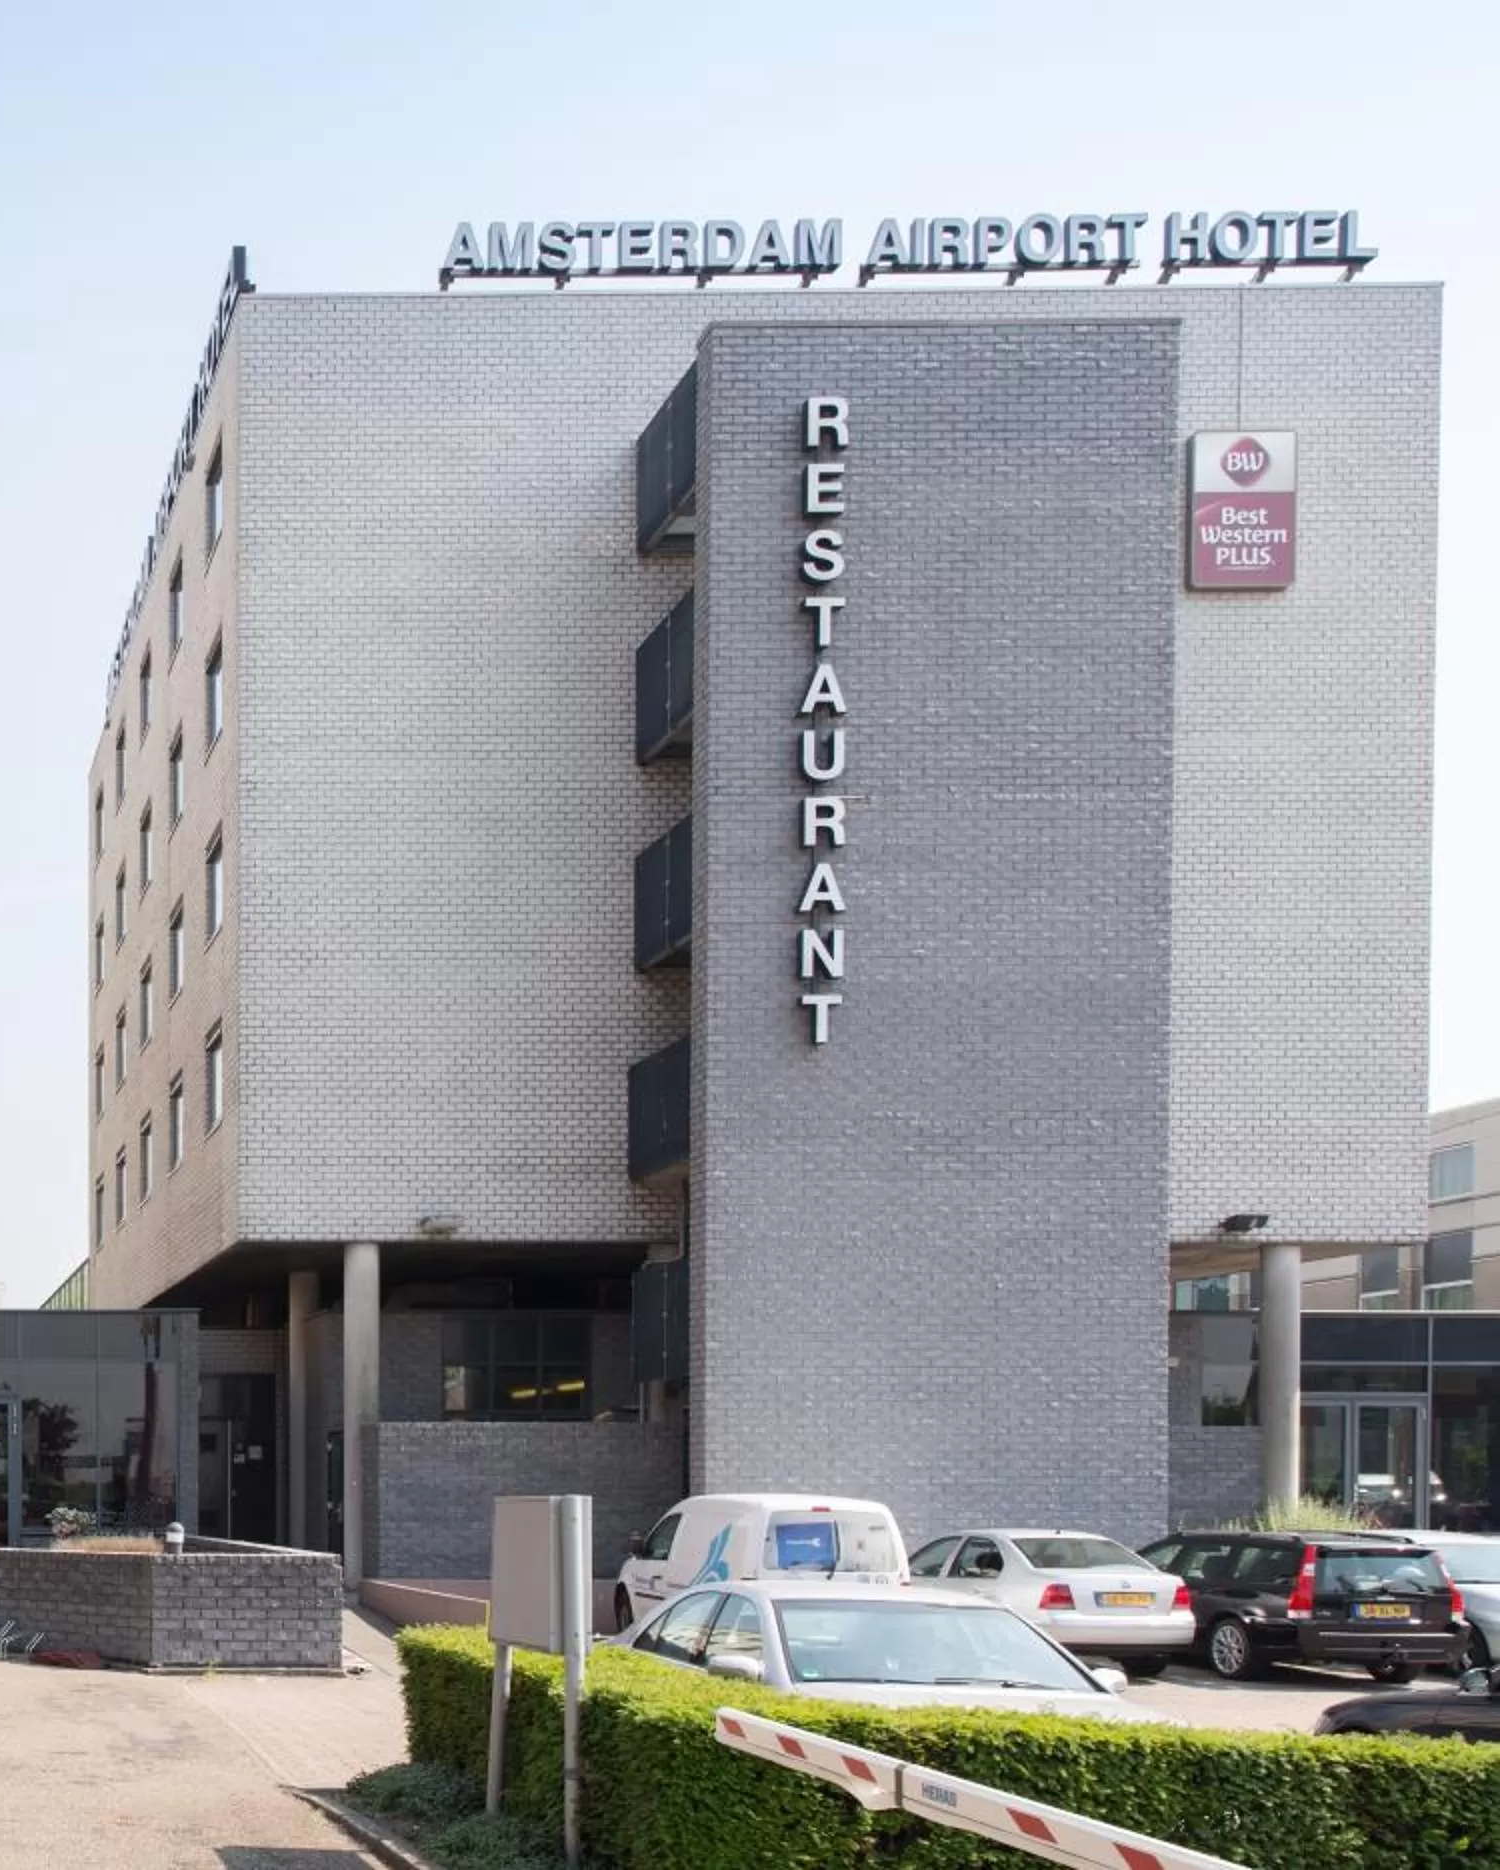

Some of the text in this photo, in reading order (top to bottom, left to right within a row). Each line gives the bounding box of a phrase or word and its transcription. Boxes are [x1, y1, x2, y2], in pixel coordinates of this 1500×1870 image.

[444, 210, 1378, 272] AMSTERDAM AIRPORT HOTEL
[1226, 451, 1265, 472] BW
[1220, 505, 1269, 526] Best
[1200, 524, 1288, 544] Western
[800, 397, 849, 1044] RESTAURANT
